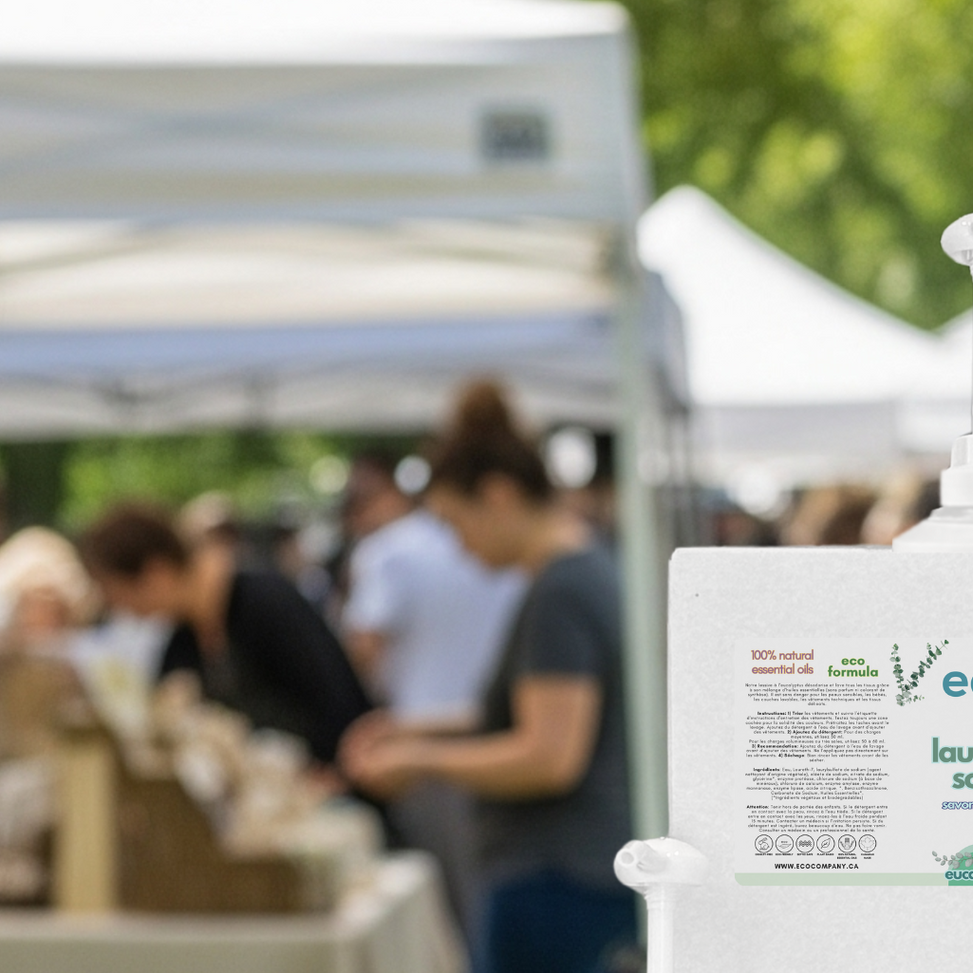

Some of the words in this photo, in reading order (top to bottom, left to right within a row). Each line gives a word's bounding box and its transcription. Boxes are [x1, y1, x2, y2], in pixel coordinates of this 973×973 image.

[750, 649, 777, 661] 100%
[779, 648, 814, 661] natural
[841, 657, 865, 666] eco
[751, 662, 795, 675] essential
[797, 662, 814, 675] oils
[827, 665, 879, 678] formula
